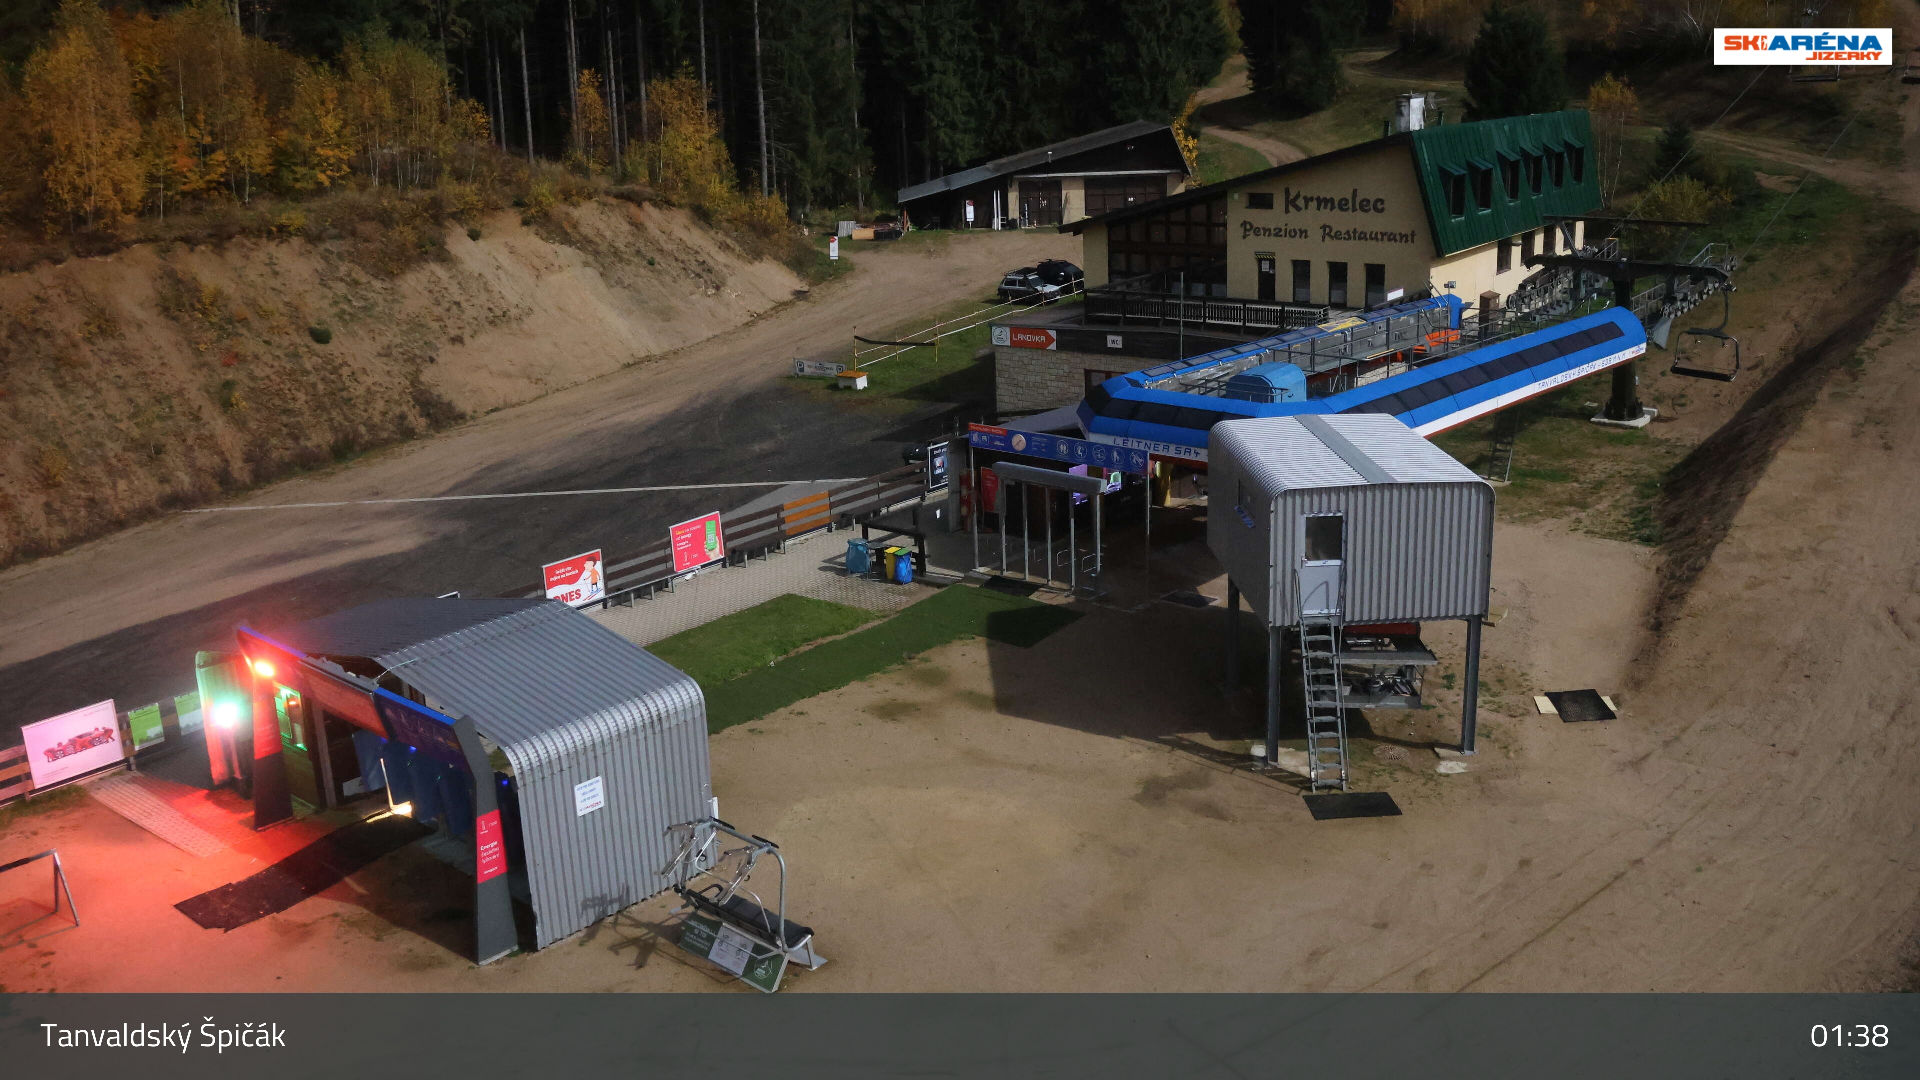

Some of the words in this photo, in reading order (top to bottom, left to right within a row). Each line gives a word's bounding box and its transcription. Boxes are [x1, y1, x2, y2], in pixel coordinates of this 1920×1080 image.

[1284, 187, 1385, 214] Krmelec
[1240, 220, 1308, 240] Penzion
[1320, 224, 1416, 244] Restaurant
[1110, 338, 1119, 346] WC
[1113, 438, 1170, 454] LEITNER
